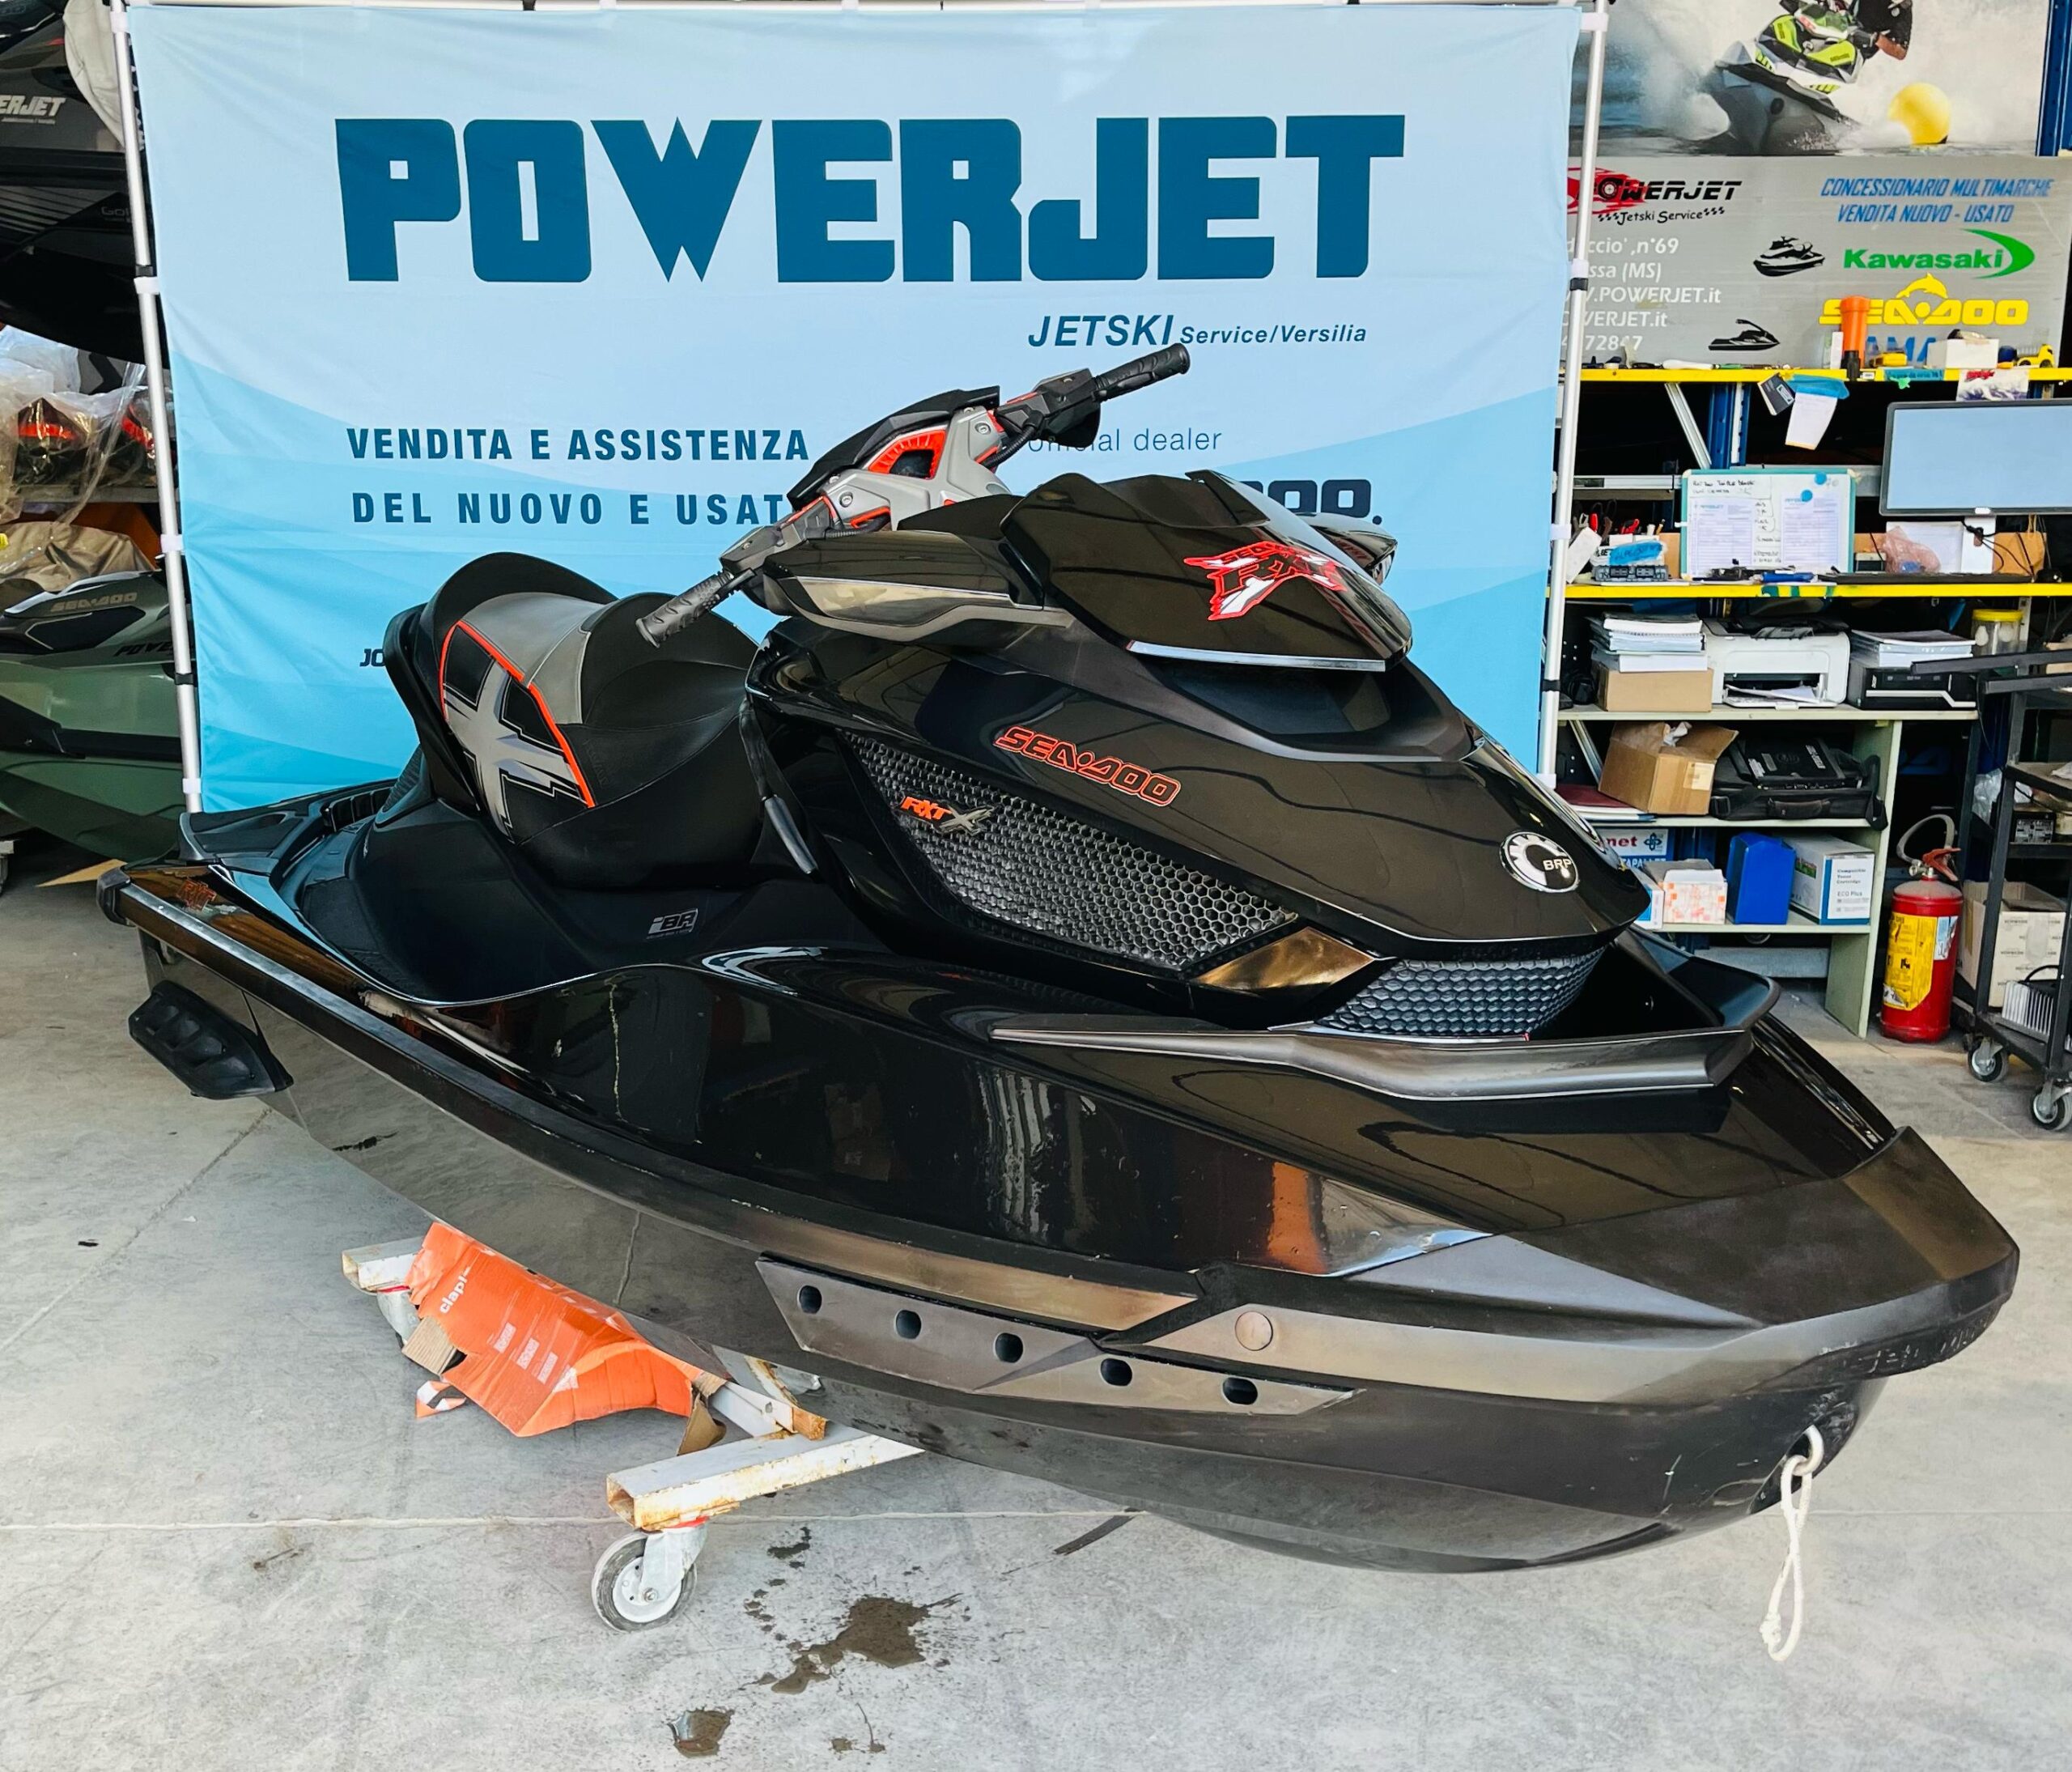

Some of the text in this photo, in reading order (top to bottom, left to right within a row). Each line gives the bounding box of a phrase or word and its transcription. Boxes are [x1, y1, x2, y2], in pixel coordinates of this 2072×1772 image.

[1820, 177, 2055, 198] CONCESSIONARIO MULTIMARCHE
[334, 115, 1405, 283] POWERJET
[1616, 210, 1704, 226] Jetski Service
[1837, 204, 1896, 223] VENDITA
[1899, 204, 1953, 223] NUOVO
[1964, 204, 2015, 223] USATO
[1844, 249, 2003, 268] Kawasaki
[1621, 261, 1661, 283] (MS)
[1028, 314, 1367, 347] JETSKI Service/Versilia
[346, 428, 809, 461] VENDITA E ASSISTENZA
[1133, 427, 1222, 451] dealer
[352, 492, 431, 525] DEL
[458, 493, 603, 525] NUOVO
[631, 494, 648, 525] E
[1543, 858, 1573, 871] BRP
